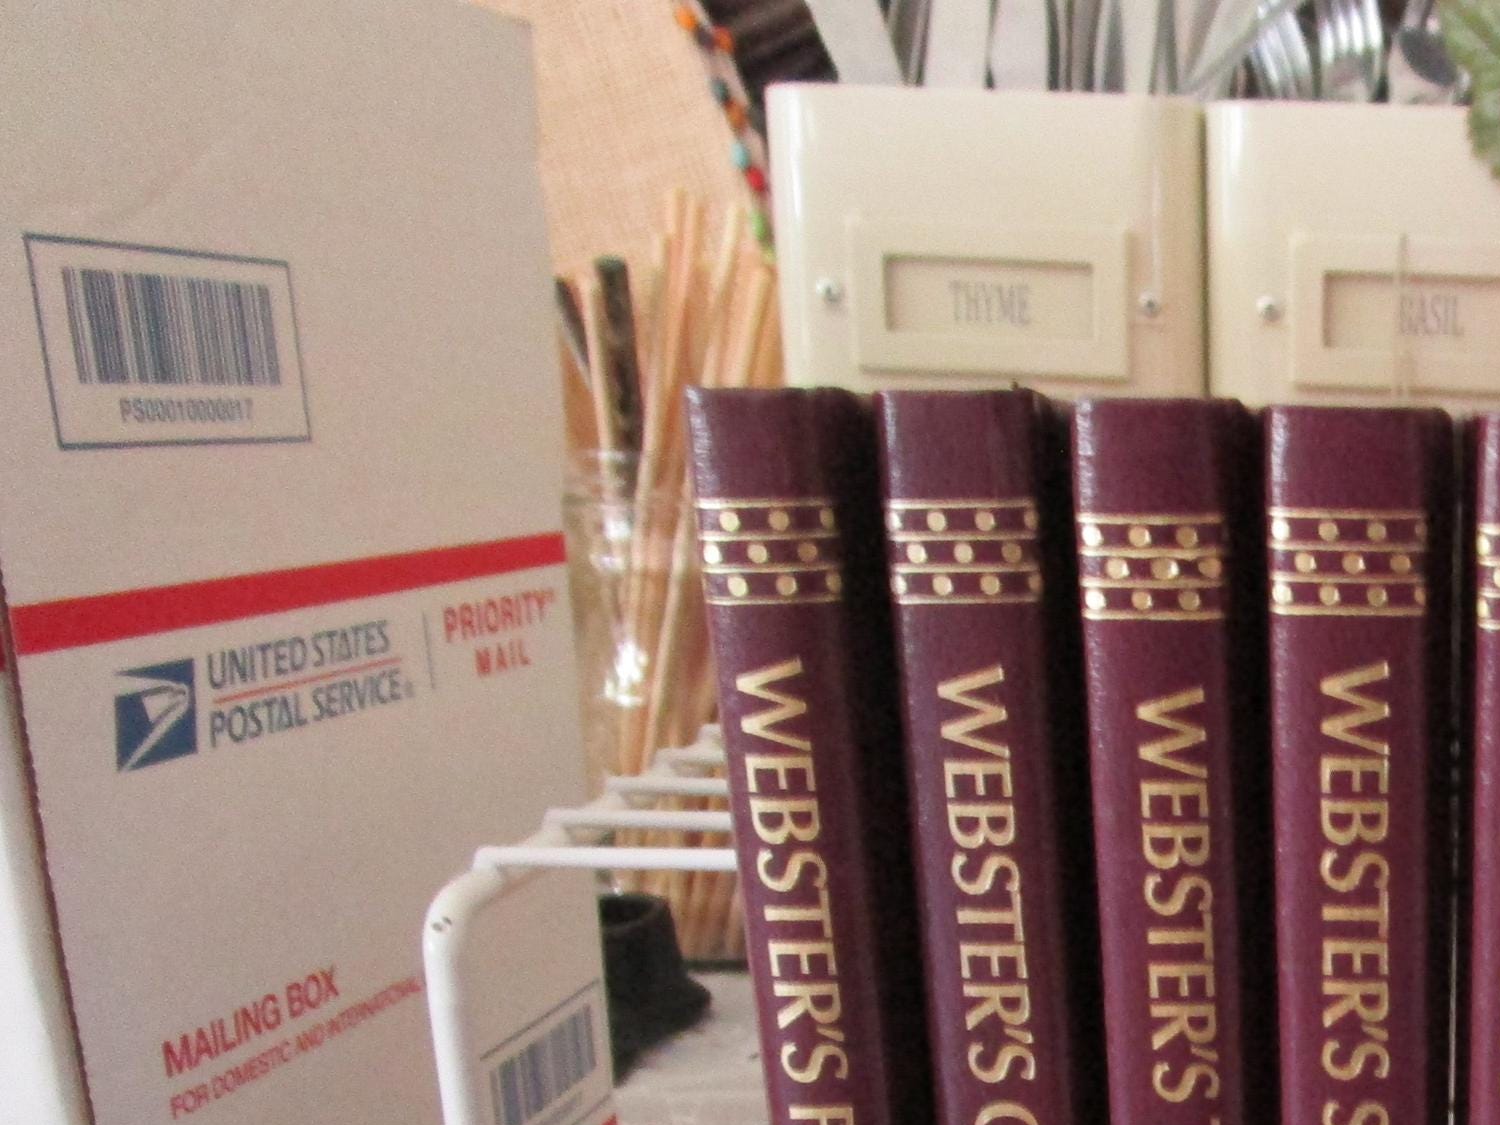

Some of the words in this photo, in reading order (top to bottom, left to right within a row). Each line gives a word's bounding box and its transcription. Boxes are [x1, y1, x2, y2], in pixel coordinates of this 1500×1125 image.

[950, 279, 1031, 327] THYME
[206, 636, 307, 691] UNITED
[311, 619, 390, 668] STATES
[474, 639, 532, 679] MAIL
[208, 695, 308, 748] POSTAL
[735, 659, 848, 1084] WEBSTER'S
[936, 665, 1036, 1084] WEBSTER'S
[1136, 688, 1221, 1103] WEBSTER'S
[1320, 660, 1391, 1082] WEBSTER'S
[161, 993, 281, 1079] MAILING
[286, 964, 340, 1019] BOX
[170, 1083, 209, 1120] FOR
[211, 1040, 291, 1100] DOMESTIC
[295, 1023, 326, 1053] AND
